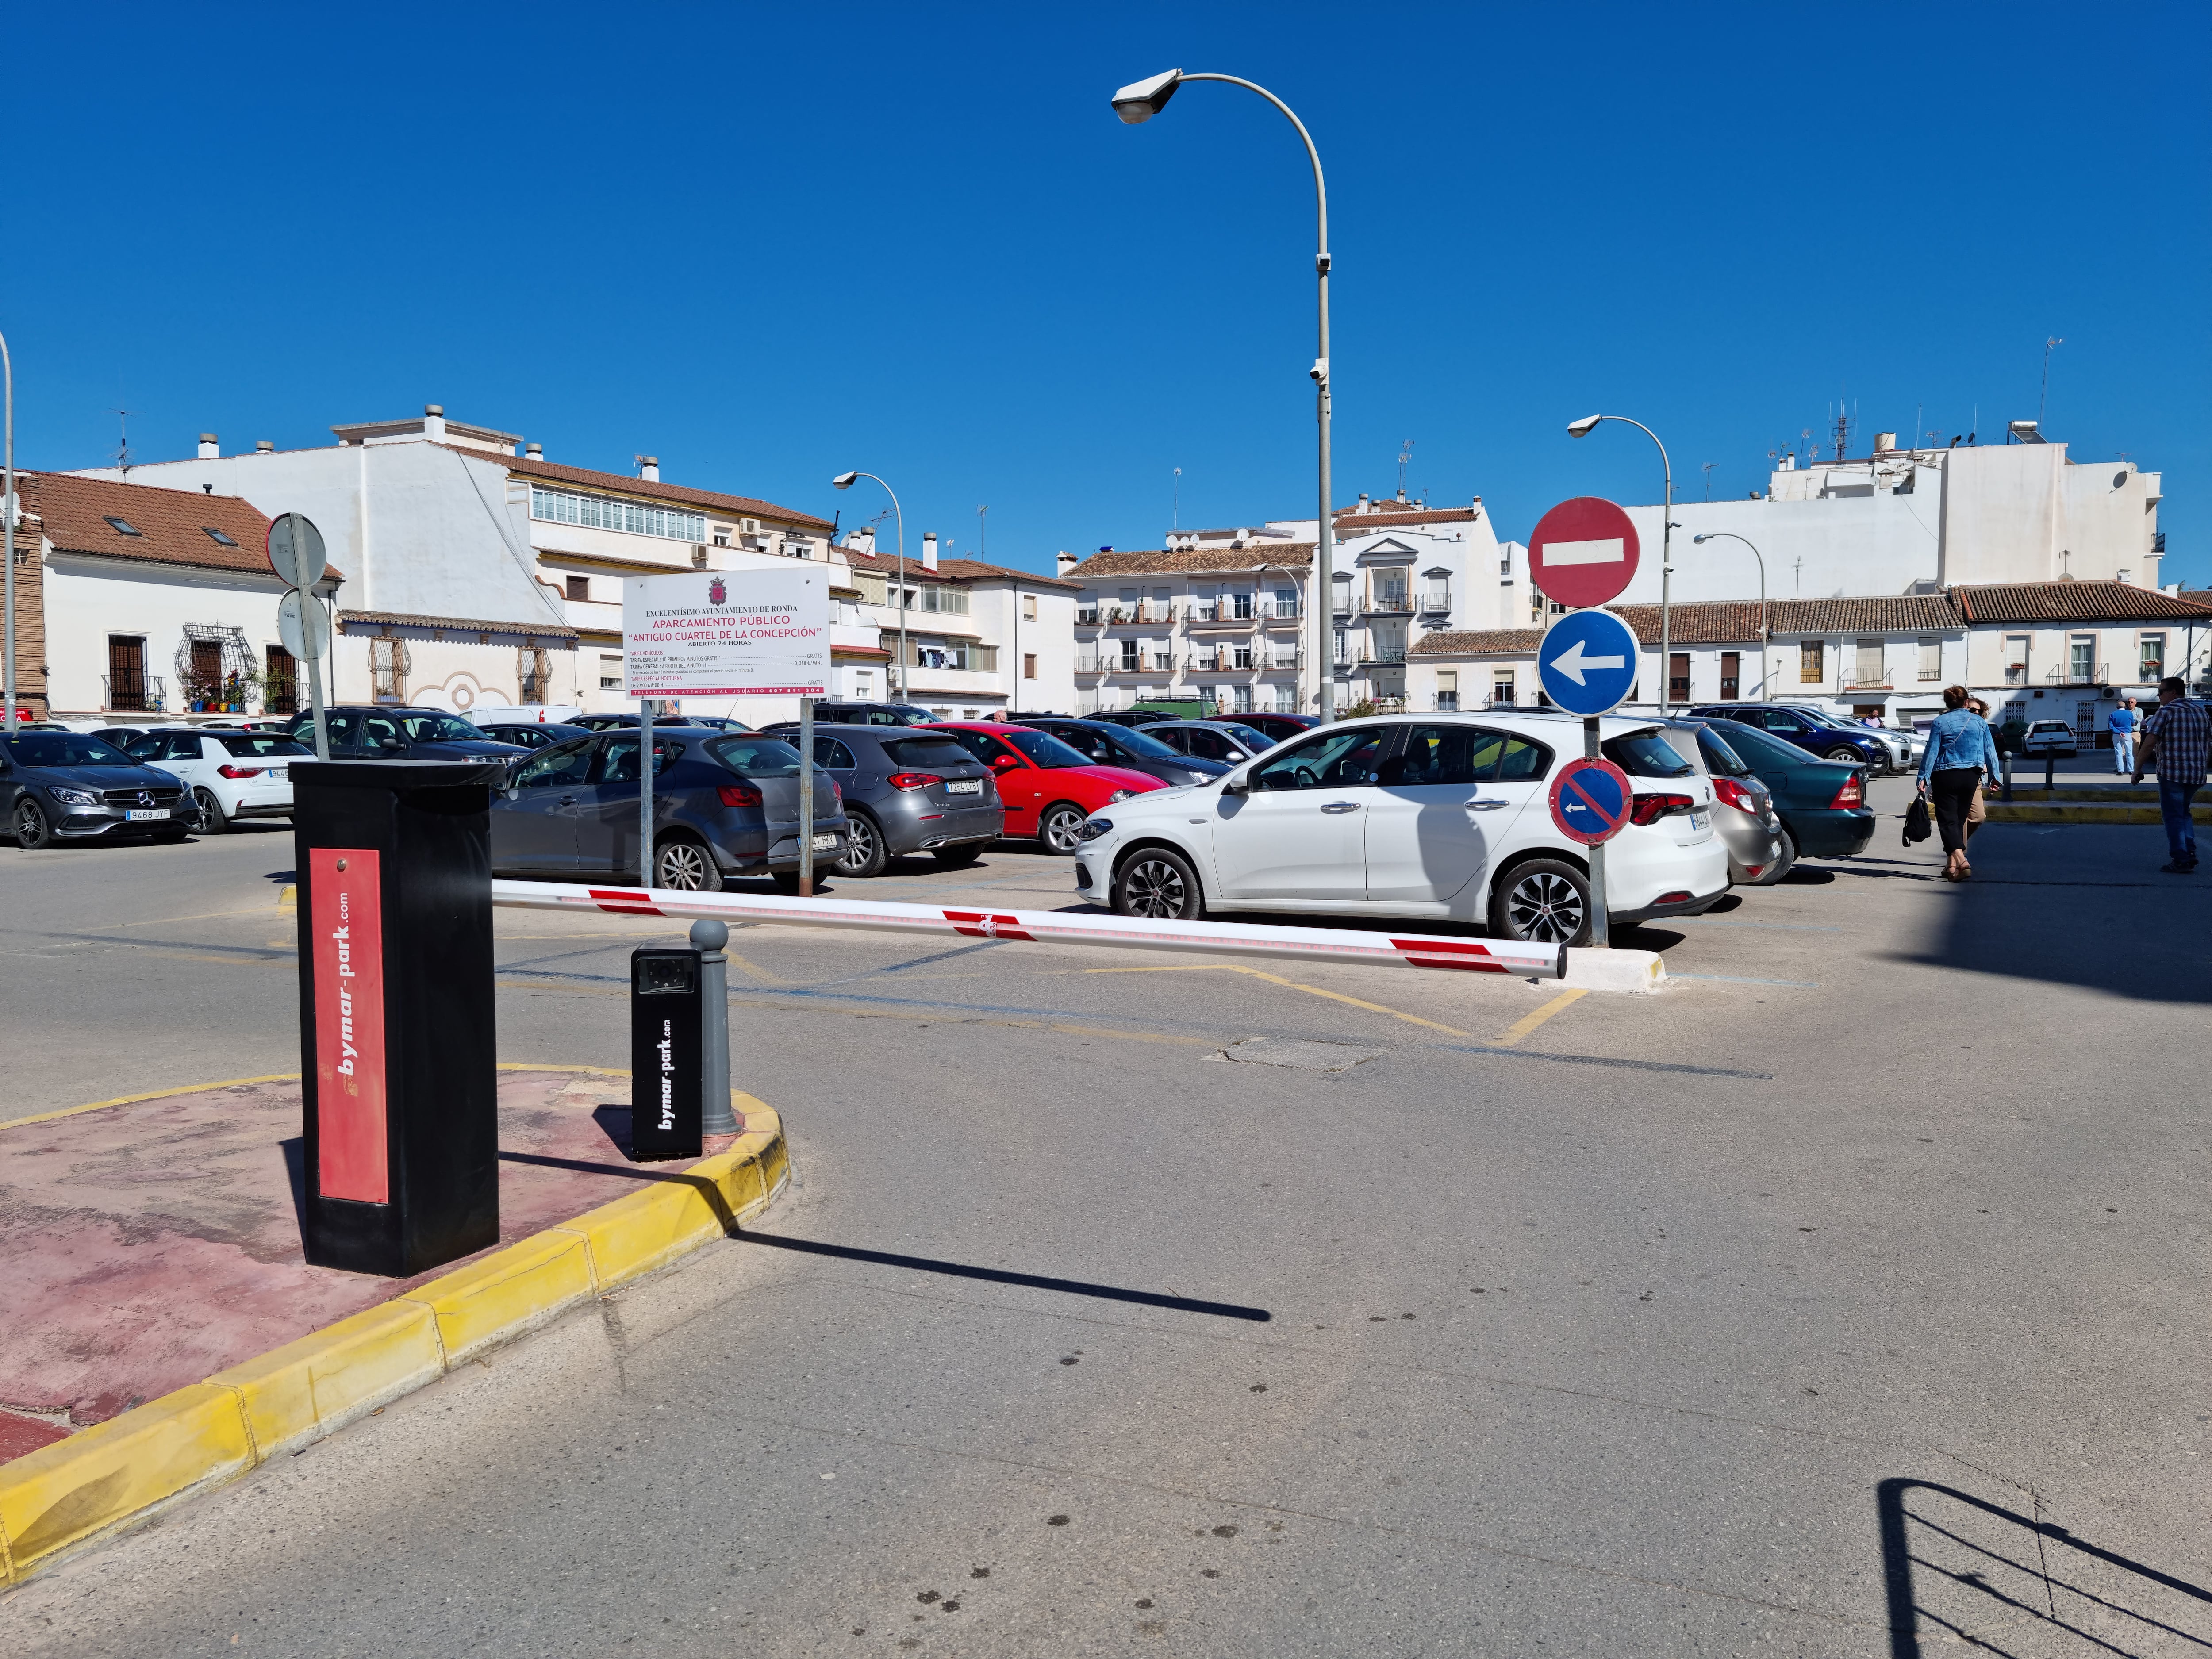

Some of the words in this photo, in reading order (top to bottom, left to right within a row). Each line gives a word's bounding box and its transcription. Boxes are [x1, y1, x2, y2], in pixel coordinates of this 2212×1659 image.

[646, 607, 700, 617] EXCELENTÍSIMO
[702, 606, 758, 615] AYUNTAMIENTO
[653, 617, 736, 629] APARCAMIENTO
[740, 614, 790, 625] PÚBLICO
[675, 631, 717, 641] CUARTEL
[719, 630, 732, 639] DE
[735, 630, 748, 639] LA
[949, 782, 964, 791] 7264
[965, 781, 977, 791] LFB
[822, 834, 833, 845] HKV
[333, 893, 358, 1075] bymar-park.com
